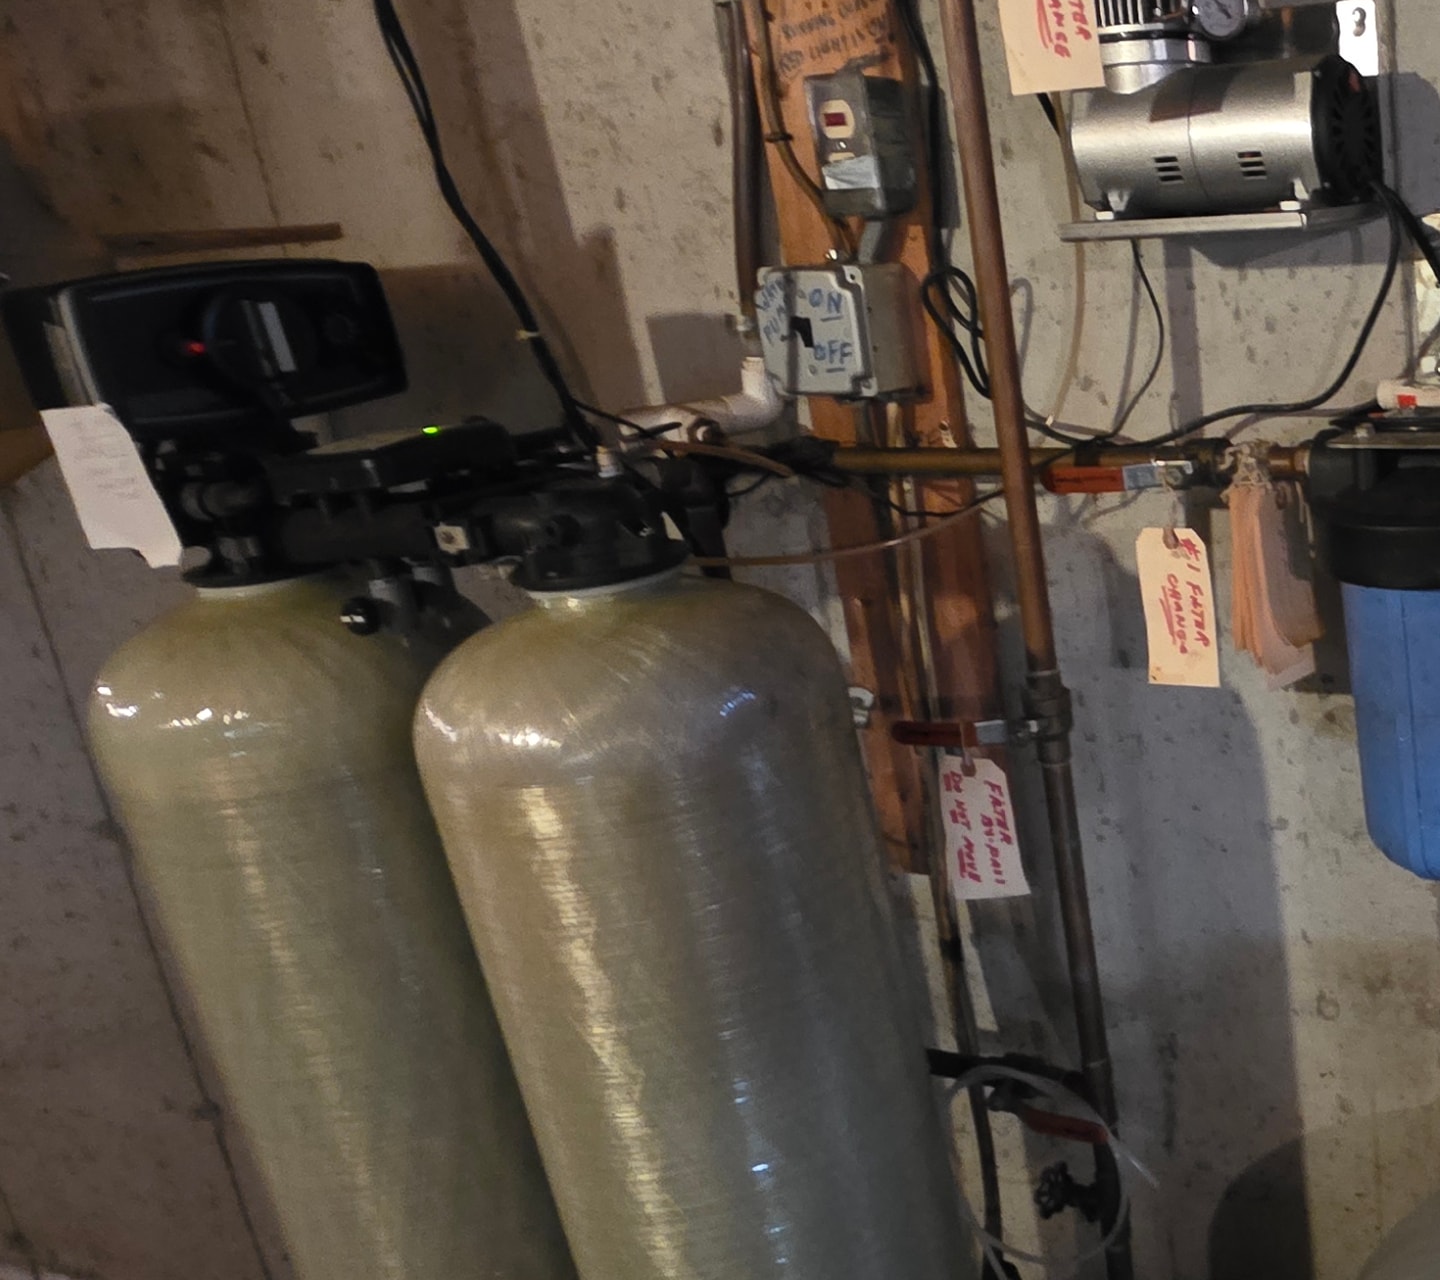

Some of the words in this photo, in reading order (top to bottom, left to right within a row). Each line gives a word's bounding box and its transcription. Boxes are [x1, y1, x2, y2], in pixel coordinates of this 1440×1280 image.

[809, 287, 843, 314] ON
[813, 340, 853, 365] OFF
[954, 799, 972, 830] NOT
[963, 835, 982, 883] MOVE
